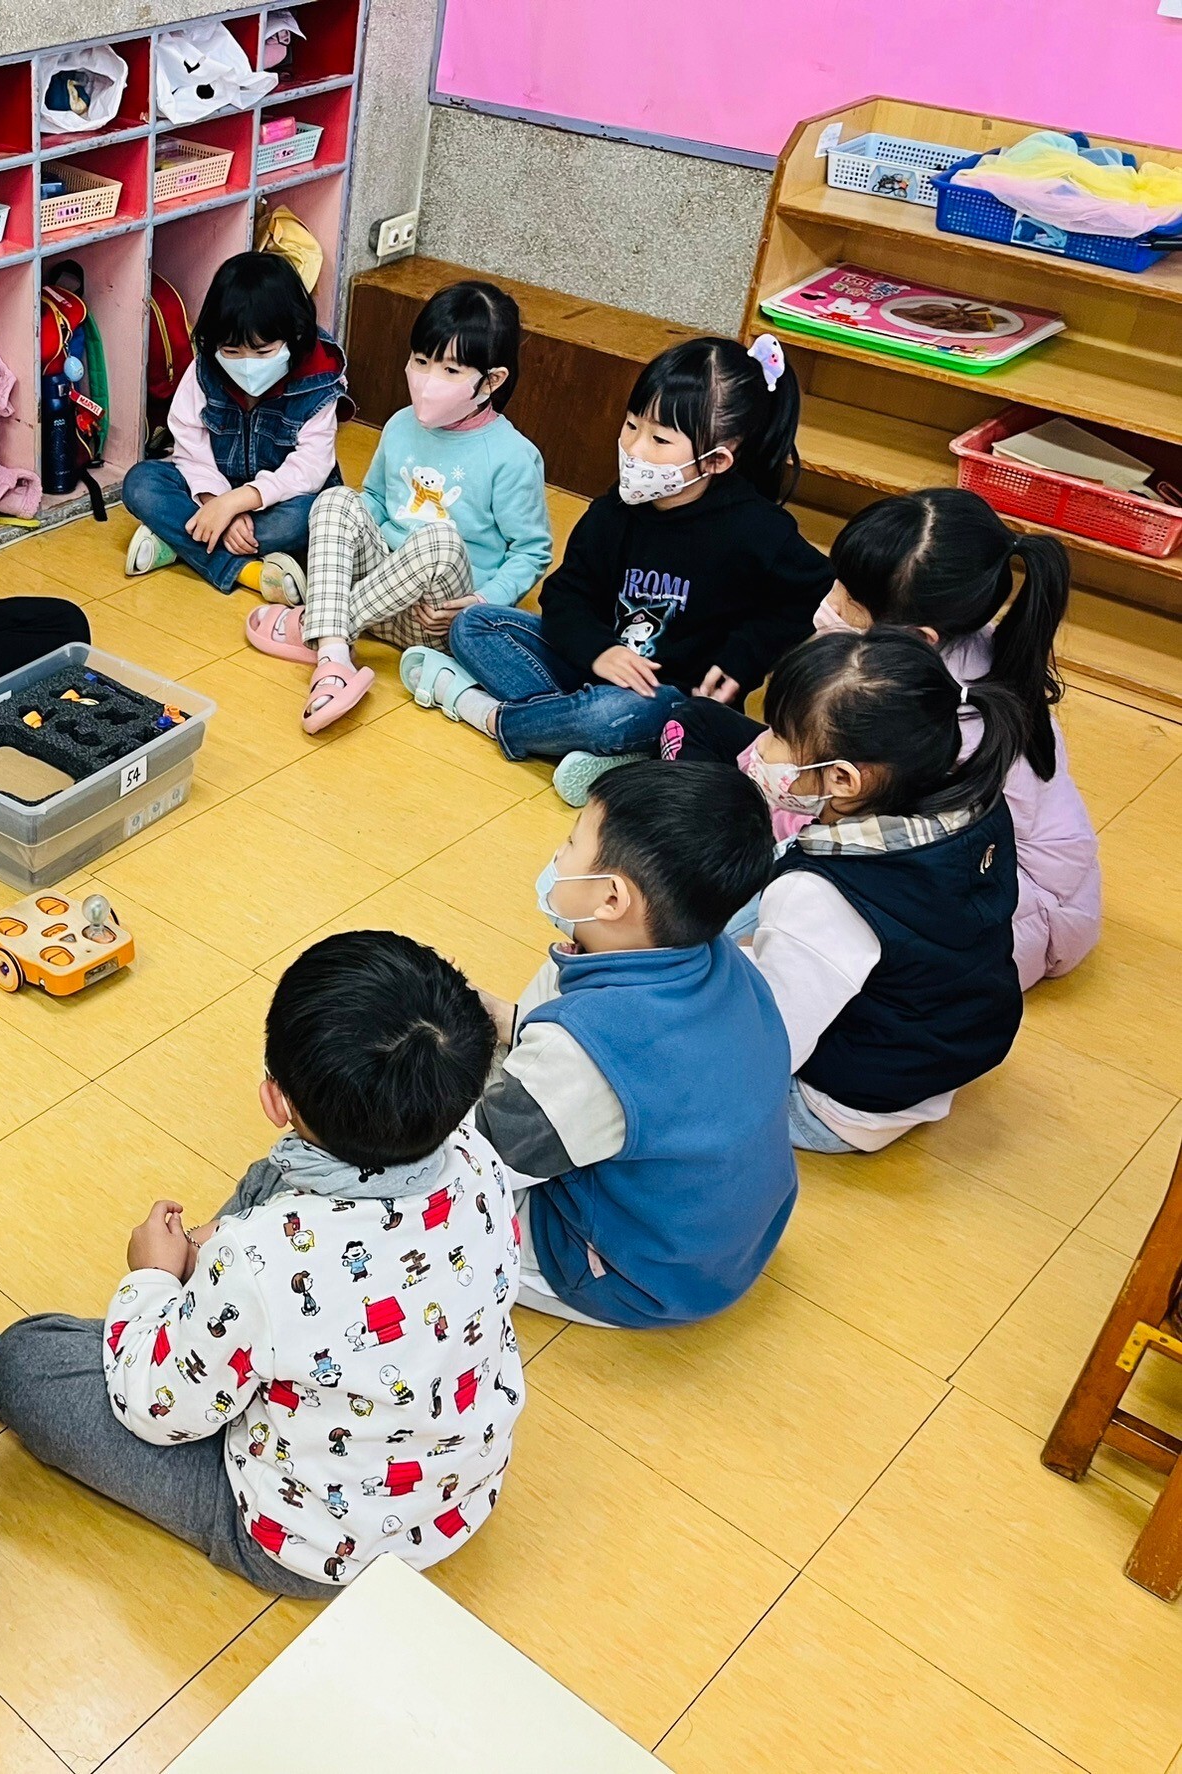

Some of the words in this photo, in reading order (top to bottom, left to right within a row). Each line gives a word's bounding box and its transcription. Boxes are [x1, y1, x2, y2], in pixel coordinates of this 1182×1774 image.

[79, 397, 101, 415] MARVEL
[622, 568, 690, 612] ROMI
[126, 767, 141, 788] 54
